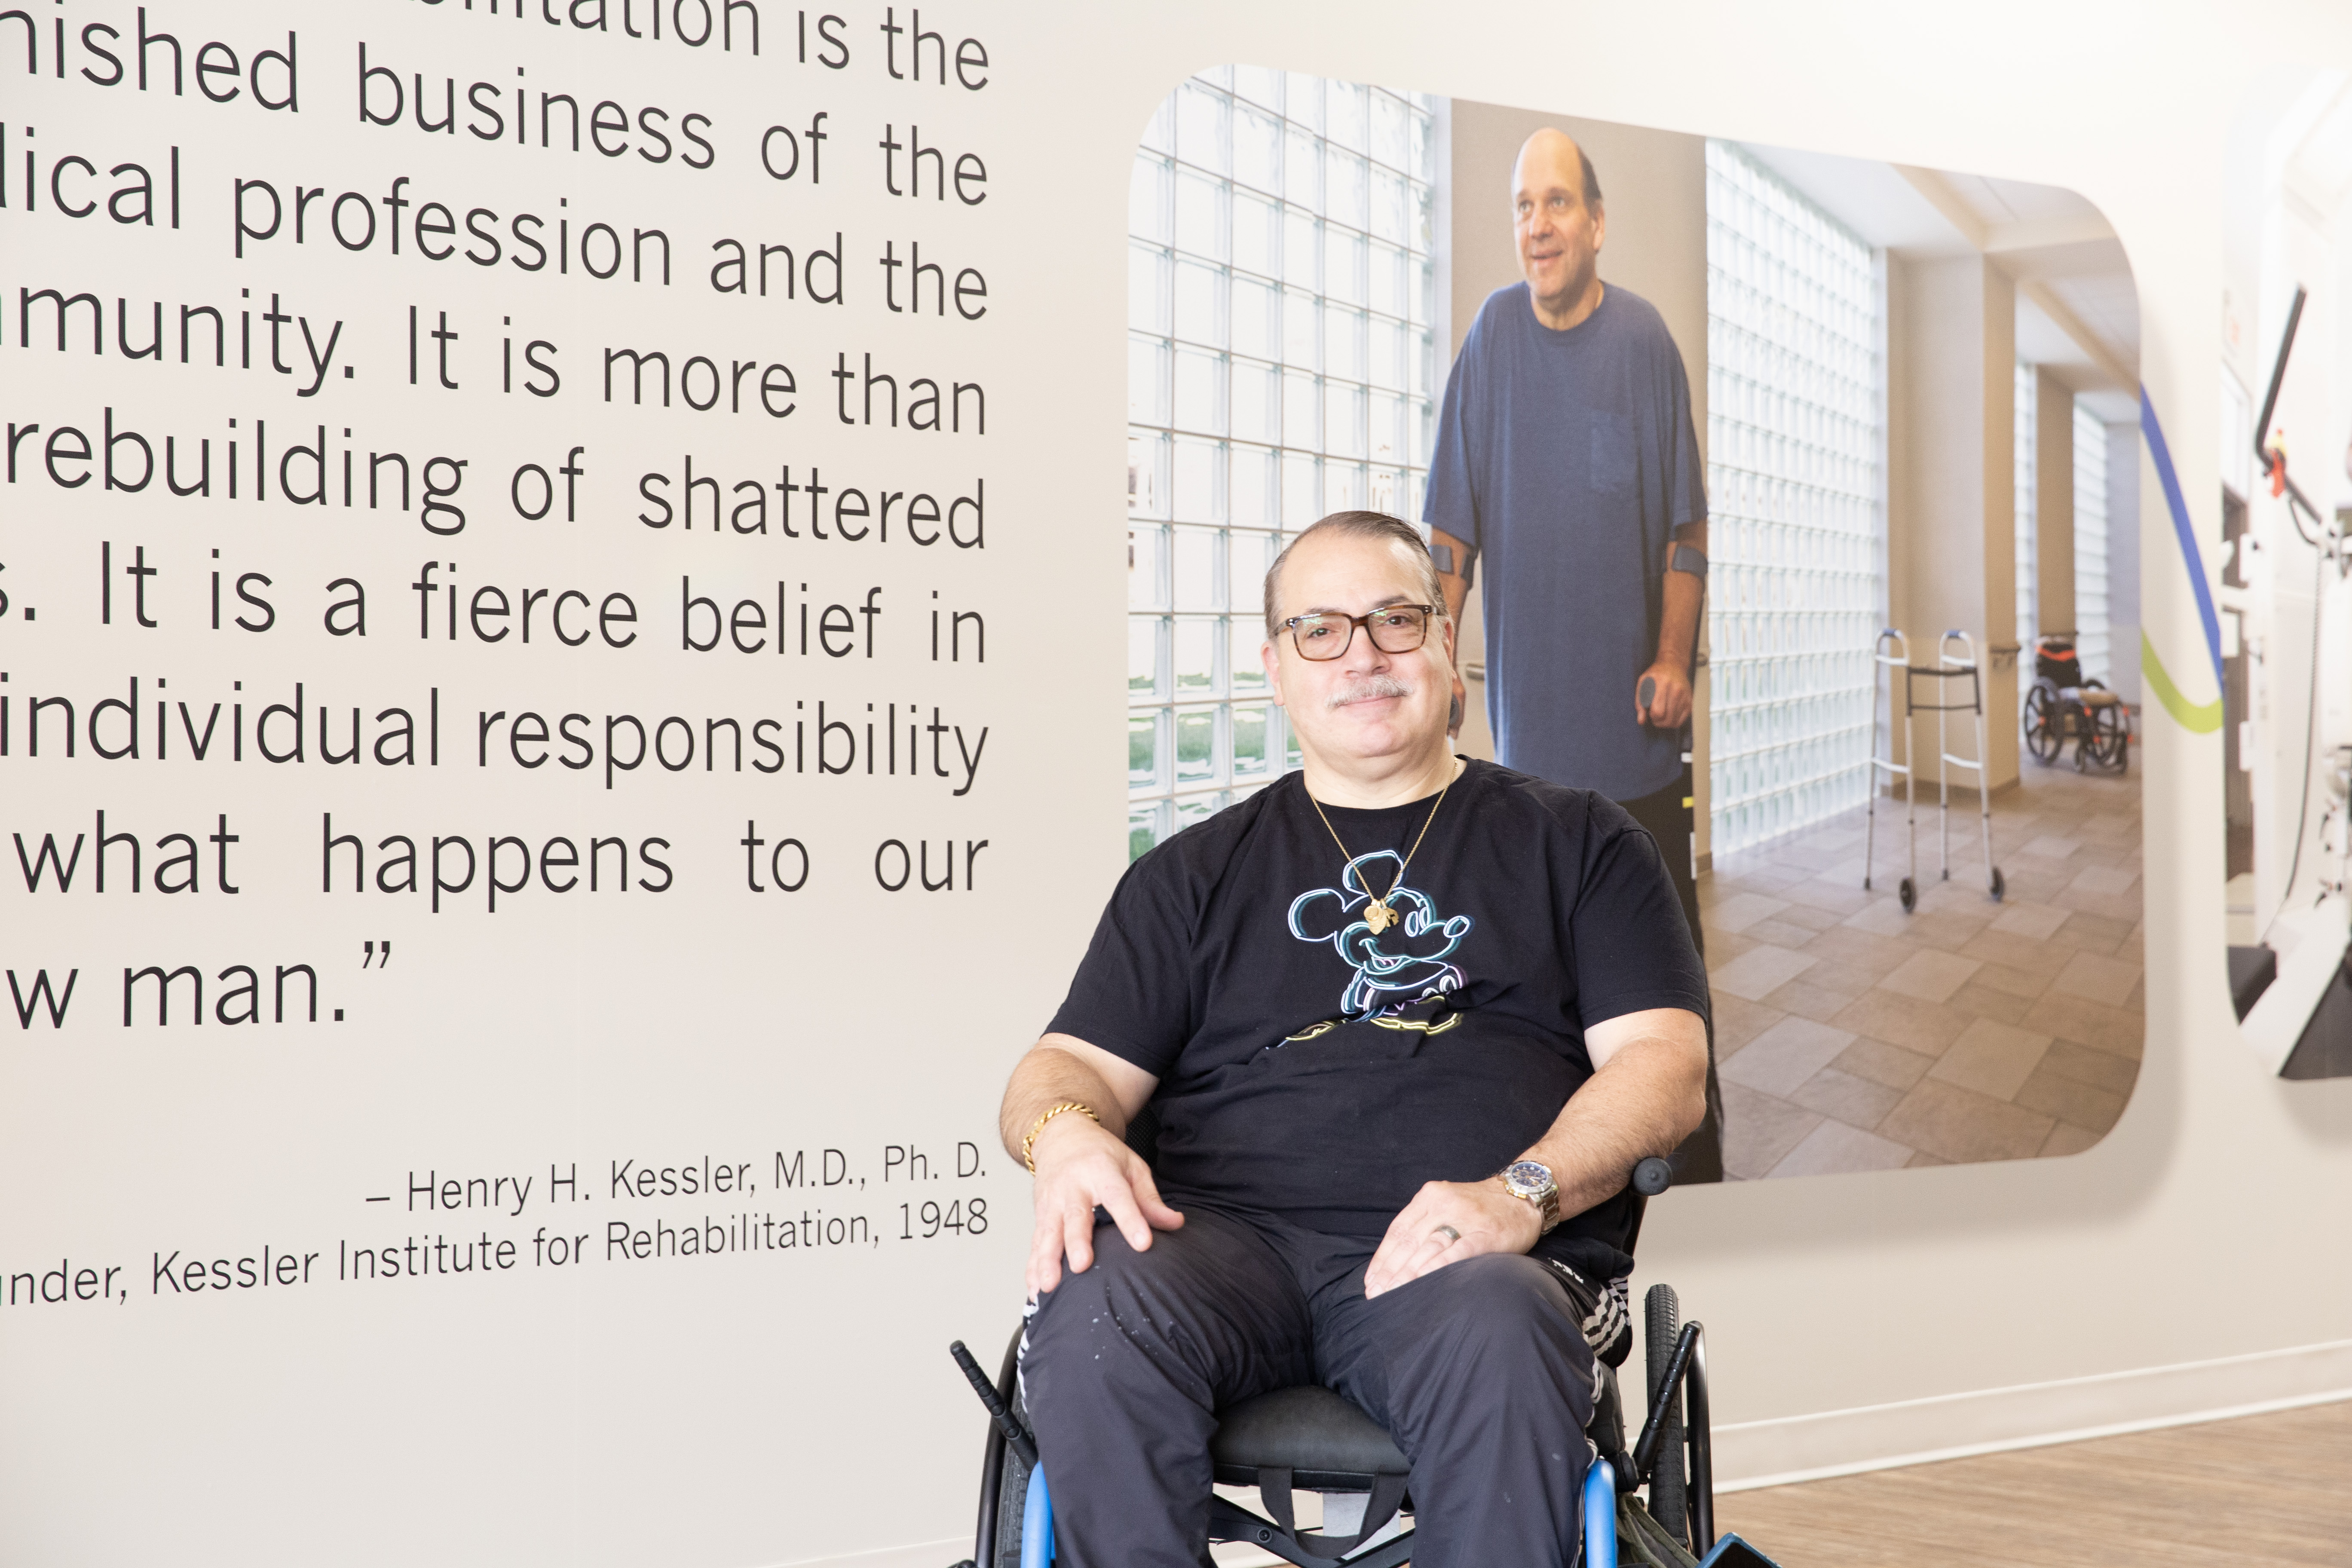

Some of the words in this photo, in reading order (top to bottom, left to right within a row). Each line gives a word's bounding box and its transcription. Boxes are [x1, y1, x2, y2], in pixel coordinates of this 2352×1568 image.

[0, 0, 298, 112] nished
[359, 42, 714, 169] business
[762, 112, 827, 184] of
[879, 124, 988, 205] the
[799, 11, 849, 69] is
[881, 7, 988, 90] the
[0, 122, 179, 229] ical
[235, 177, 669, 285] profession
[711, 232, 843, 305] and
[880, 241, 987, 320] the
[0, 288, 353, 397] munity.
[410, 306, 458, 389] It
[504, 316, 560, 397] is
[605, 348, 796, 418] more
[832, 352, 984, 435] than
[8, 407, 468, 536] rebuilding
[511, 447, 584, 522] of
[639, 455, 984, 548] shattered
[102, 541, 157, 628] It
[212, 549, 275, 632] is
[325, 578, 366, 636] a
[412, 561, 637, 648] fierce
[683, 576, 881, 658] belief
[932, 591, 983, 662] in
[0, 672, 438, 766] individual
[480, 701, 988, 796] responsibility
[13, 810, 239, 894] what
[323, 813, 673, 913] happens
[741, 820, 809, 892] to
[875, 839, 988, 891] our
[6, 969, 78, 1029] w
[409, 1170, 532, 1216] Henry
[551, 1164, 589, 1203] H.
[612, 1156, 754, 1198] Kessler,
[776, 1149, 864, 1190] M.D.,
[885, 1145, 937, 1182] Ph.
[958, 1142, 985, 1177] D.
[0, 1259, 126, 1305] nder,
[153, 1245, 318, 1294] Kessler
[341, 1232, 515, 1280] Institute
[533, 1227, 588, 1266] for
[608, 1211, 878, 1260] Rehabilitation,
[900, 1198, 987, 1239] 1948
